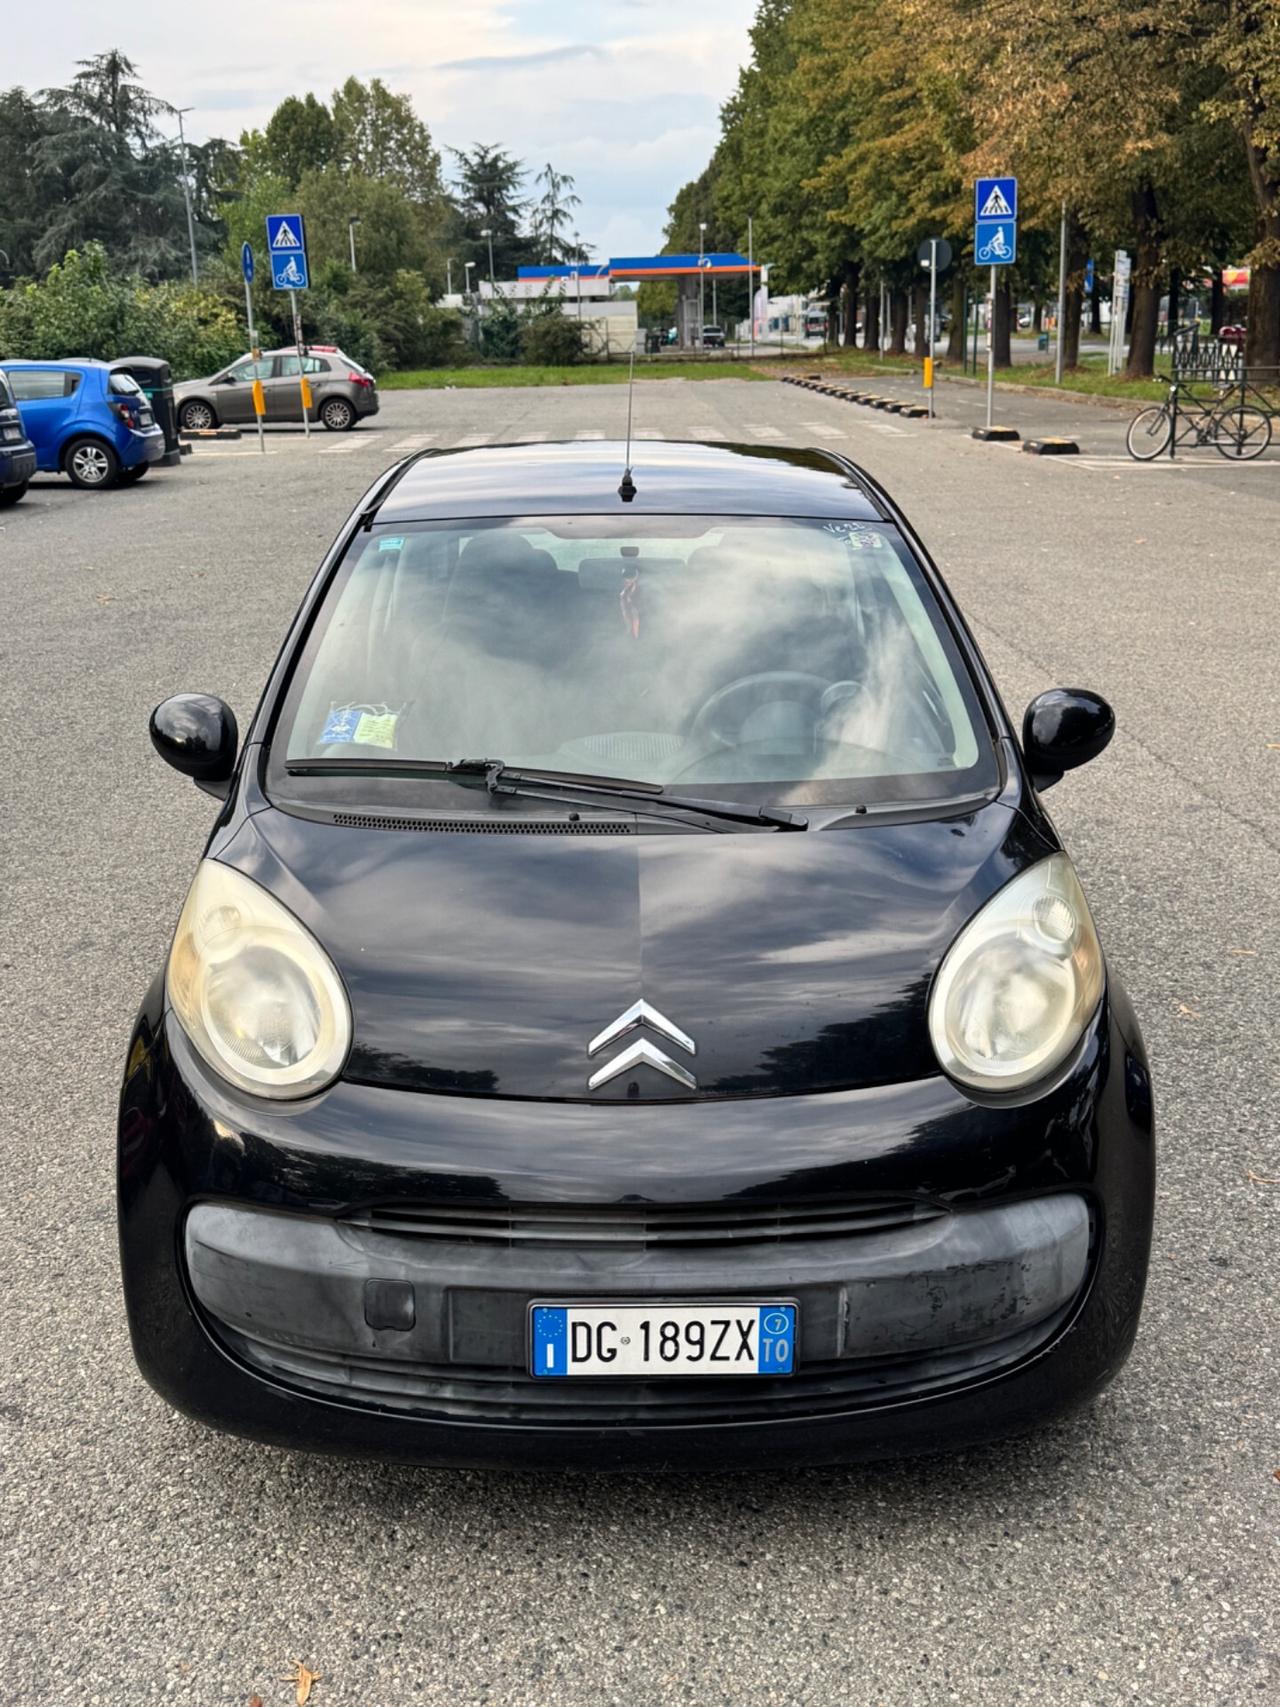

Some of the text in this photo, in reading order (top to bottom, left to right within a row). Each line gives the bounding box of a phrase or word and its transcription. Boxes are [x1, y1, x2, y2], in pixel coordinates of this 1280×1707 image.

[571, 1319, 756, 1363] DG 189ZX
[762, 1338, 789, 1362] TO
[546, 1343, 555, 1369] I
